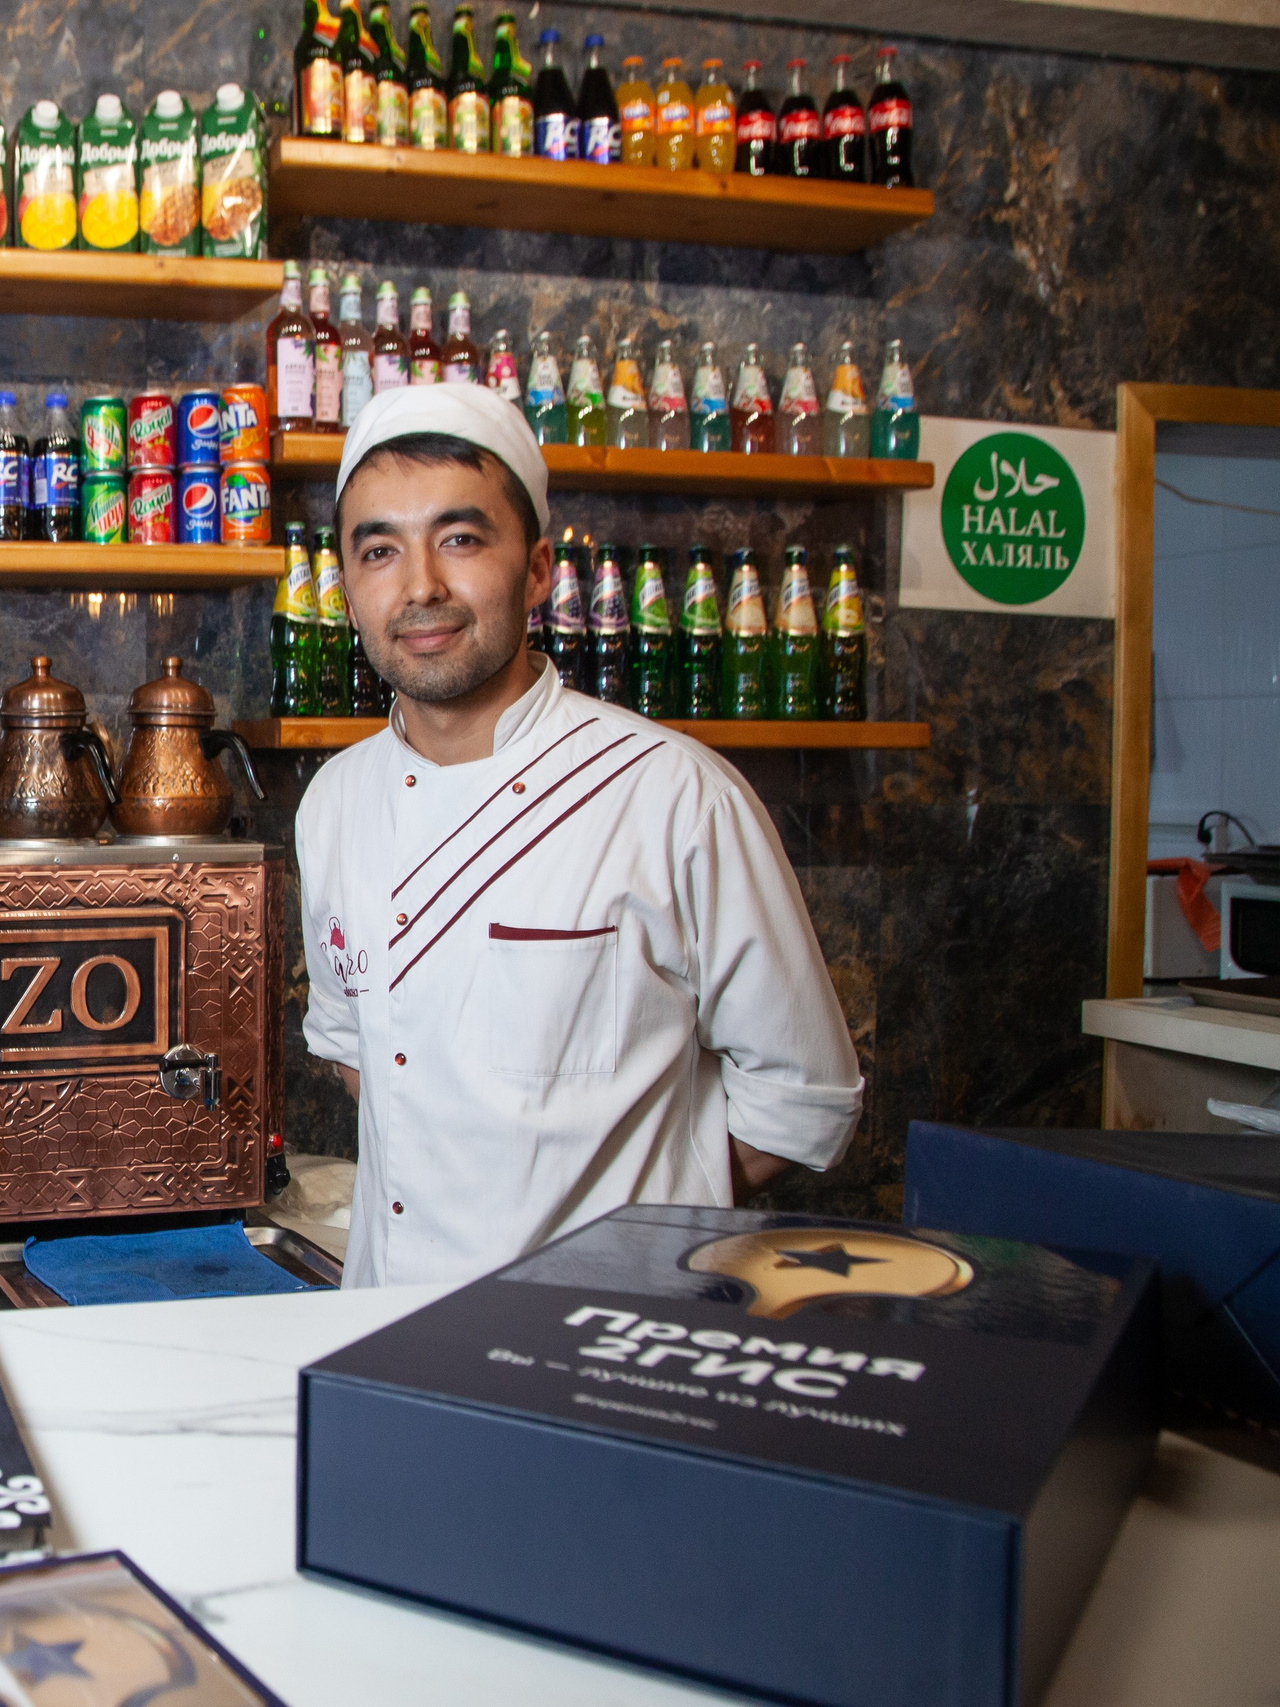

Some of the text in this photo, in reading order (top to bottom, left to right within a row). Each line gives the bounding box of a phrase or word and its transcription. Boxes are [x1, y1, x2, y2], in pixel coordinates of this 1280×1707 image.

[131, 408, 173, 443] Royal
[50, 462, 78, 490] RC
[973, 451, 1061, 501] حلال
[131, 487, 173, 521] Royal
[961, 504, 1067, 539] HALAL
[960, 540, 1070, 571] ХАЛЯЛЬ
[563, 1304, 926, 1383] Премия
[577, 1336, 848, 1399] 2ГИС
